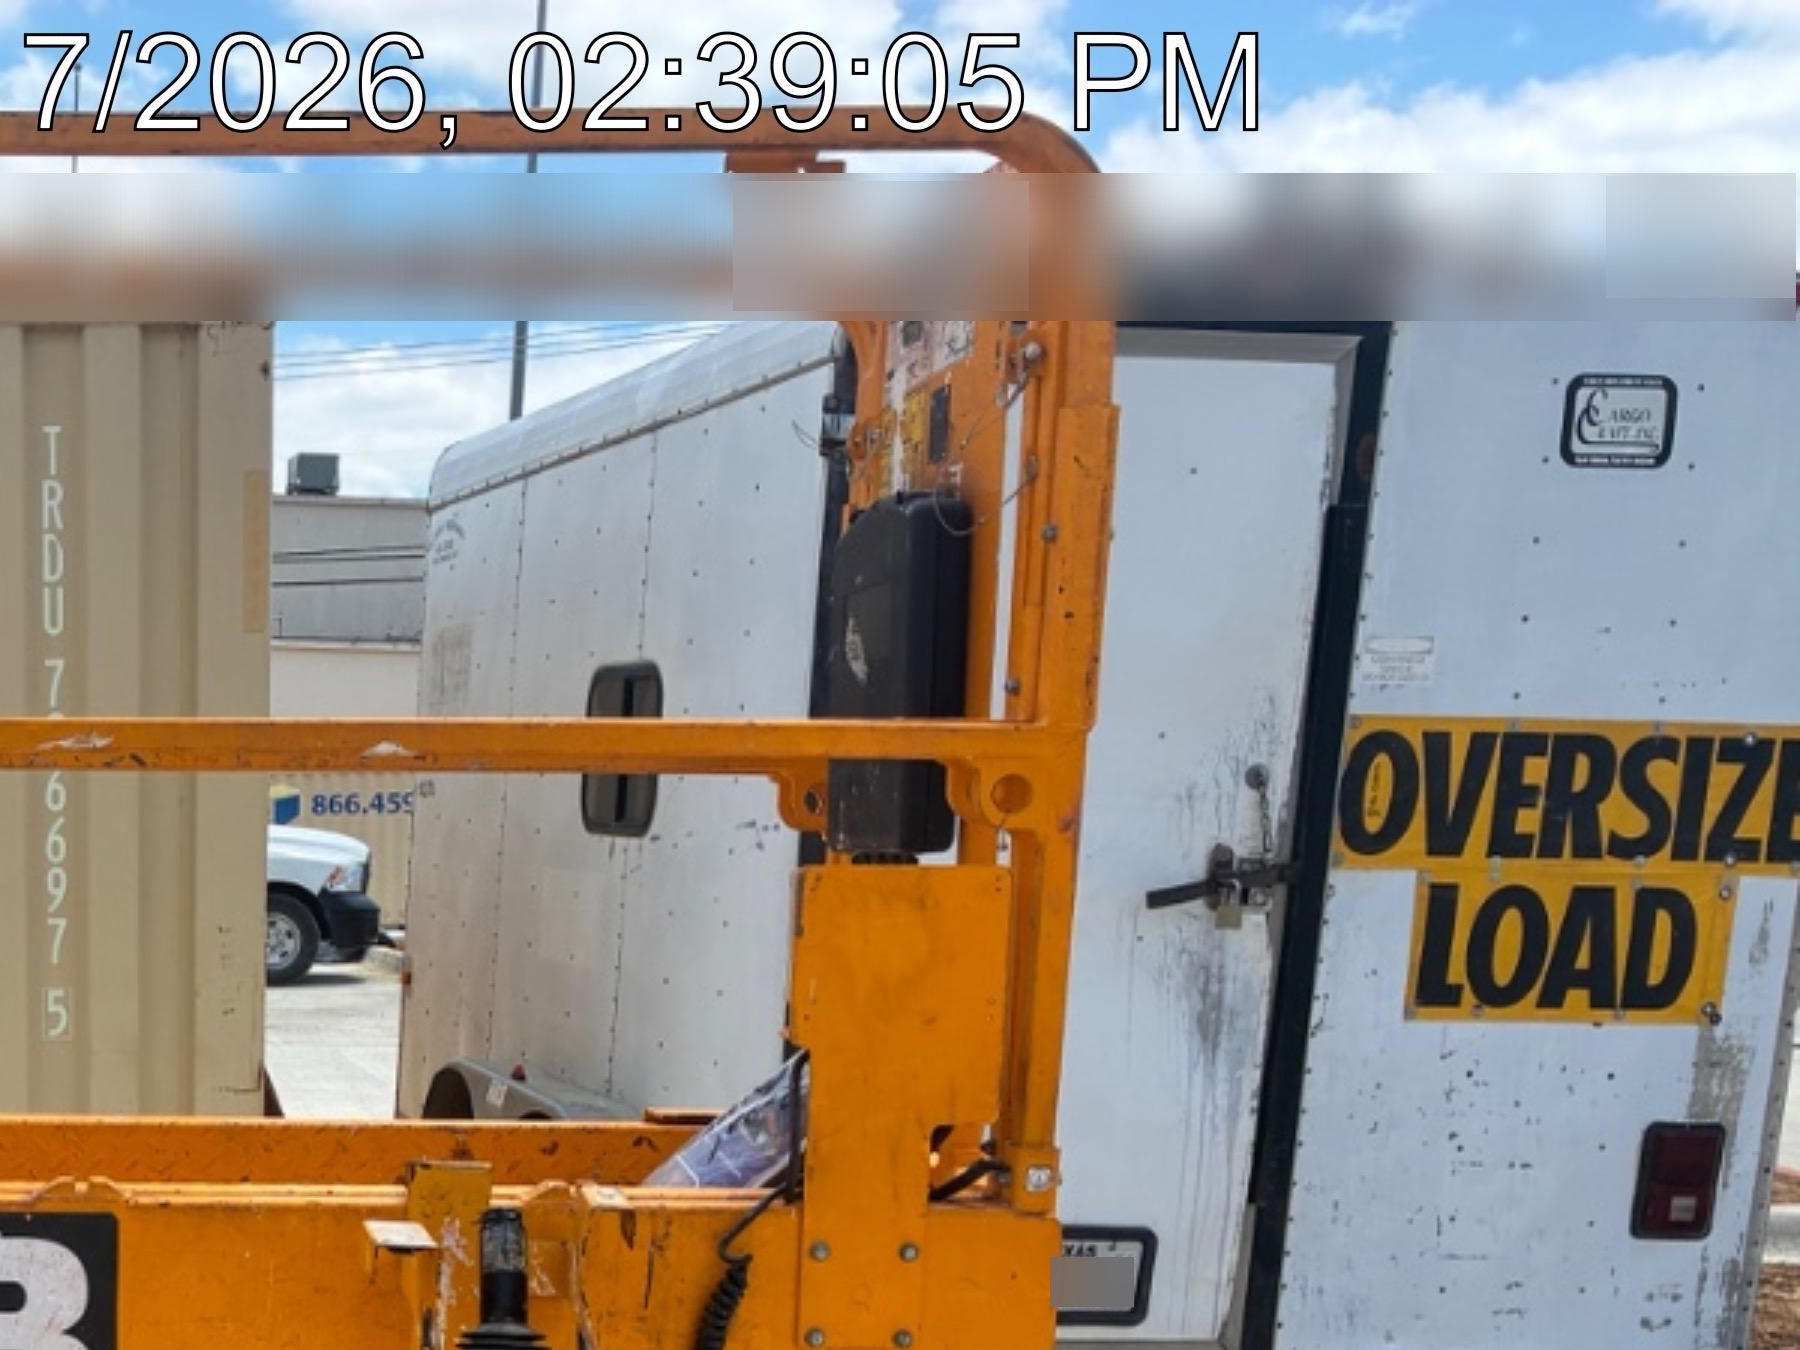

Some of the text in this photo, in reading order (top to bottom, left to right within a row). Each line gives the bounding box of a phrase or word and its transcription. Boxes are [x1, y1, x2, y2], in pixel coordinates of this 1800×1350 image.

[41, 426, 68, 1036] TRDU 76697 5
[1337, 730, 1800, 863] OVERSIZE
[1414, 882, 1697, 1011] LOAD
